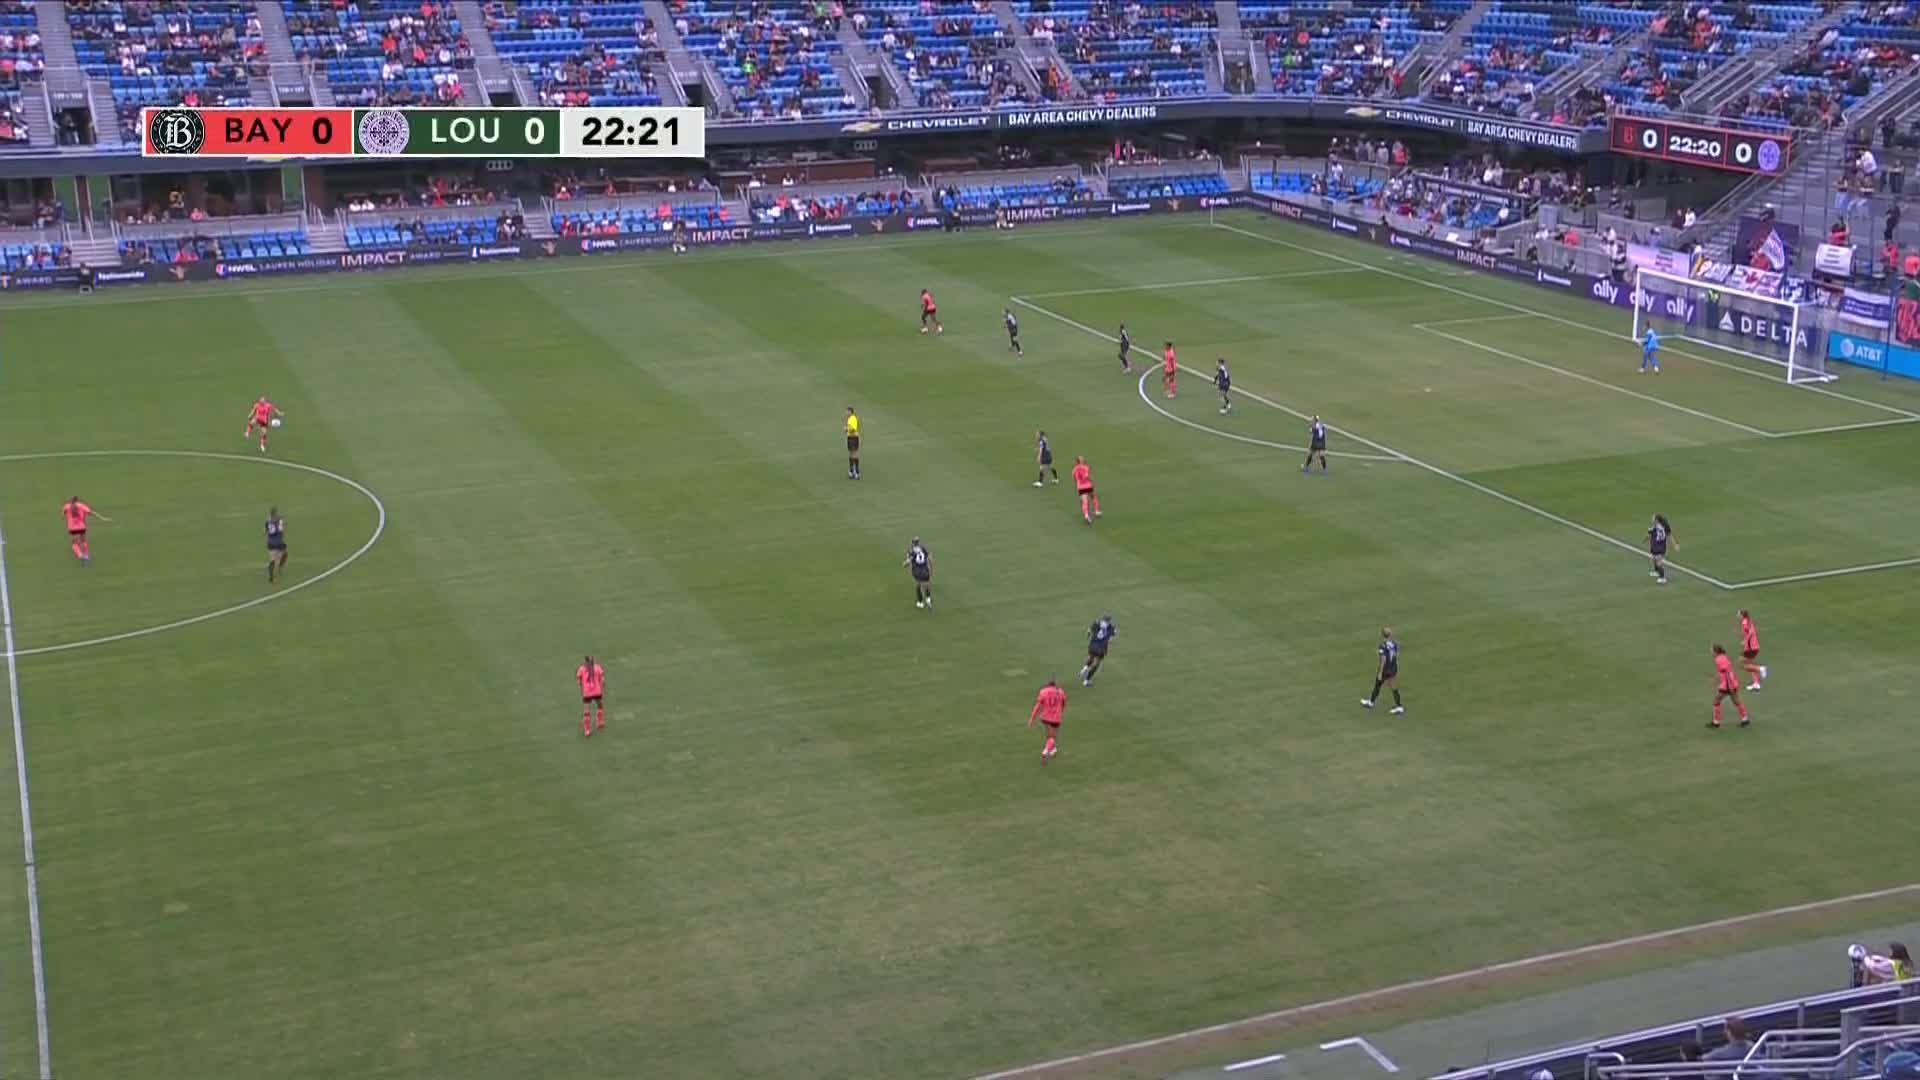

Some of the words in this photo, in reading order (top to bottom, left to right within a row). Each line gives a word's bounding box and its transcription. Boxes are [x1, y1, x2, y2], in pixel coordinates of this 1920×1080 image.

[887, 116, 990, 130] CHEVROLET
[1008, 113, 1031, 125] BAY
[1033, 111, 1064, 124] AREA
[1066, 109, 1104, 122] CHEVY
[1106, 106, 1157, 119] DEALERS
[1385, 109, 1456, 128] CHEVROLET
[1467, 120, 1485, 135] BAY
[1484, 124, 1508, 139] AREA
[1508, 127, 1538, 144] CHEVY
[1537, 131, 1578, 150] DEALERS
[1642, 128, 1658, 149] 0
[1669, 135, 1722, 158] 22:20
[1735, 142, 1752, 164] 0
[1006, 206, 1059, 221] IMPACT
[1270, 200, 1303, 219] IMPACT
[692, 227, 750, 242] IMPACT
[341, 250, 407, 268] IMPACT
[1456, 249, 1497, 269] IMPACT
[1593, 279, 1619, 304] ally
[1666, 297, 1695, 323] ally
[1740, 315, 1809, 349] DELTA
[1855, 343, 1883, 362] AT&T
